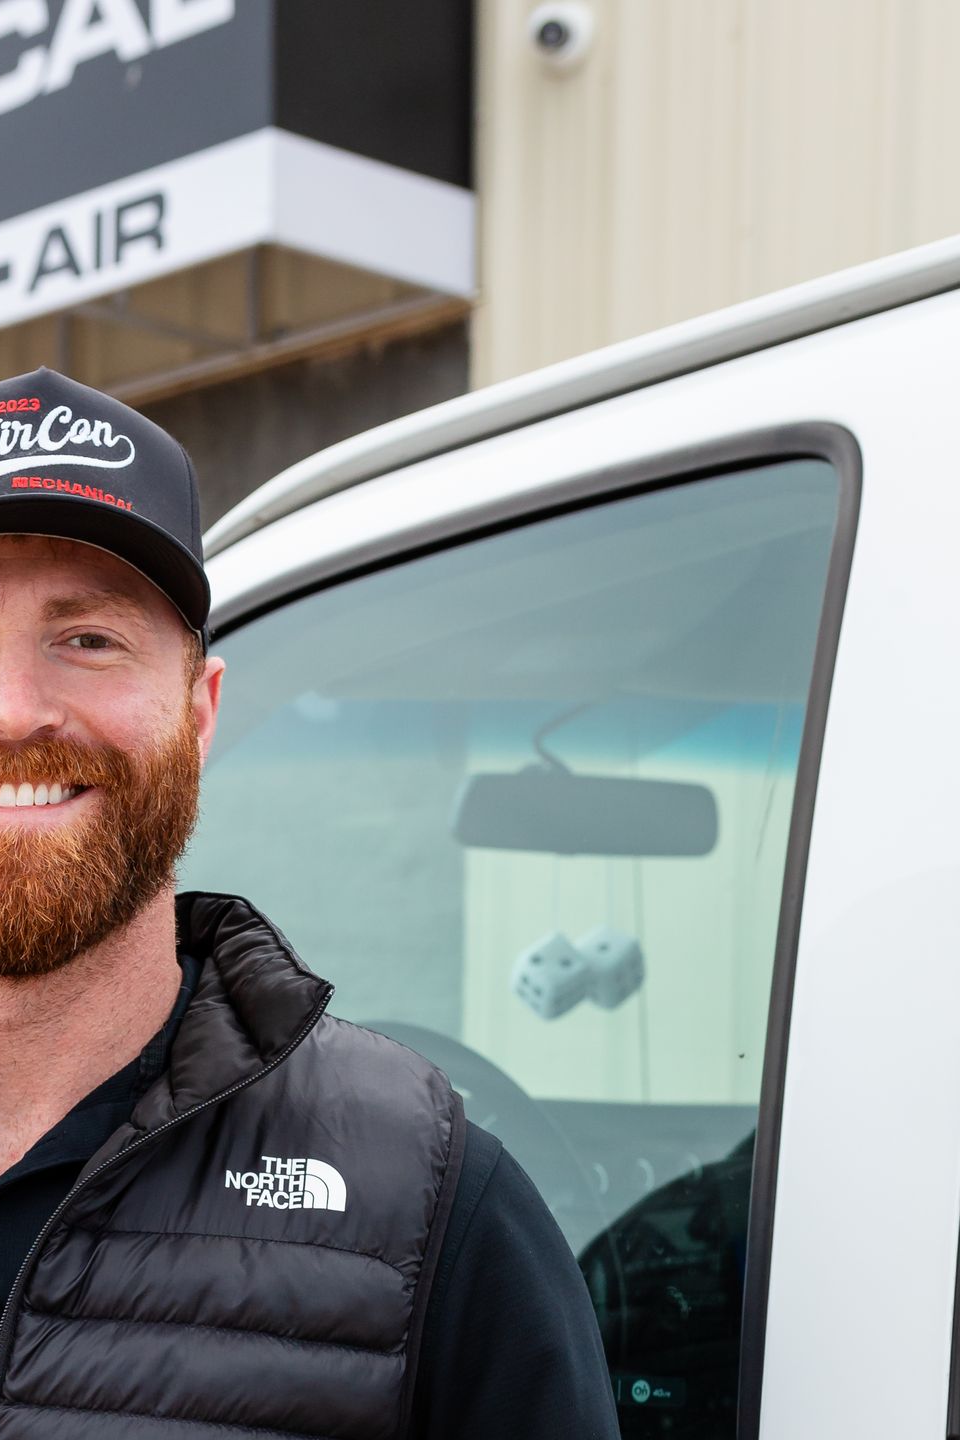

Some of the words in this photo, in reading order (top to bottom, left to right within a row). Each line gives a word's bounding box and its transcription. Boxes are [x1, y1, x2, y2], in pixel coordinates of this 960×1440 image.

[28, 190, 170, 293] AIR
[261, 1155, 307, 1175] THE
[224, 1169, 305, 1193] NORTH
[246, 1188, 303, 1210] FACE
